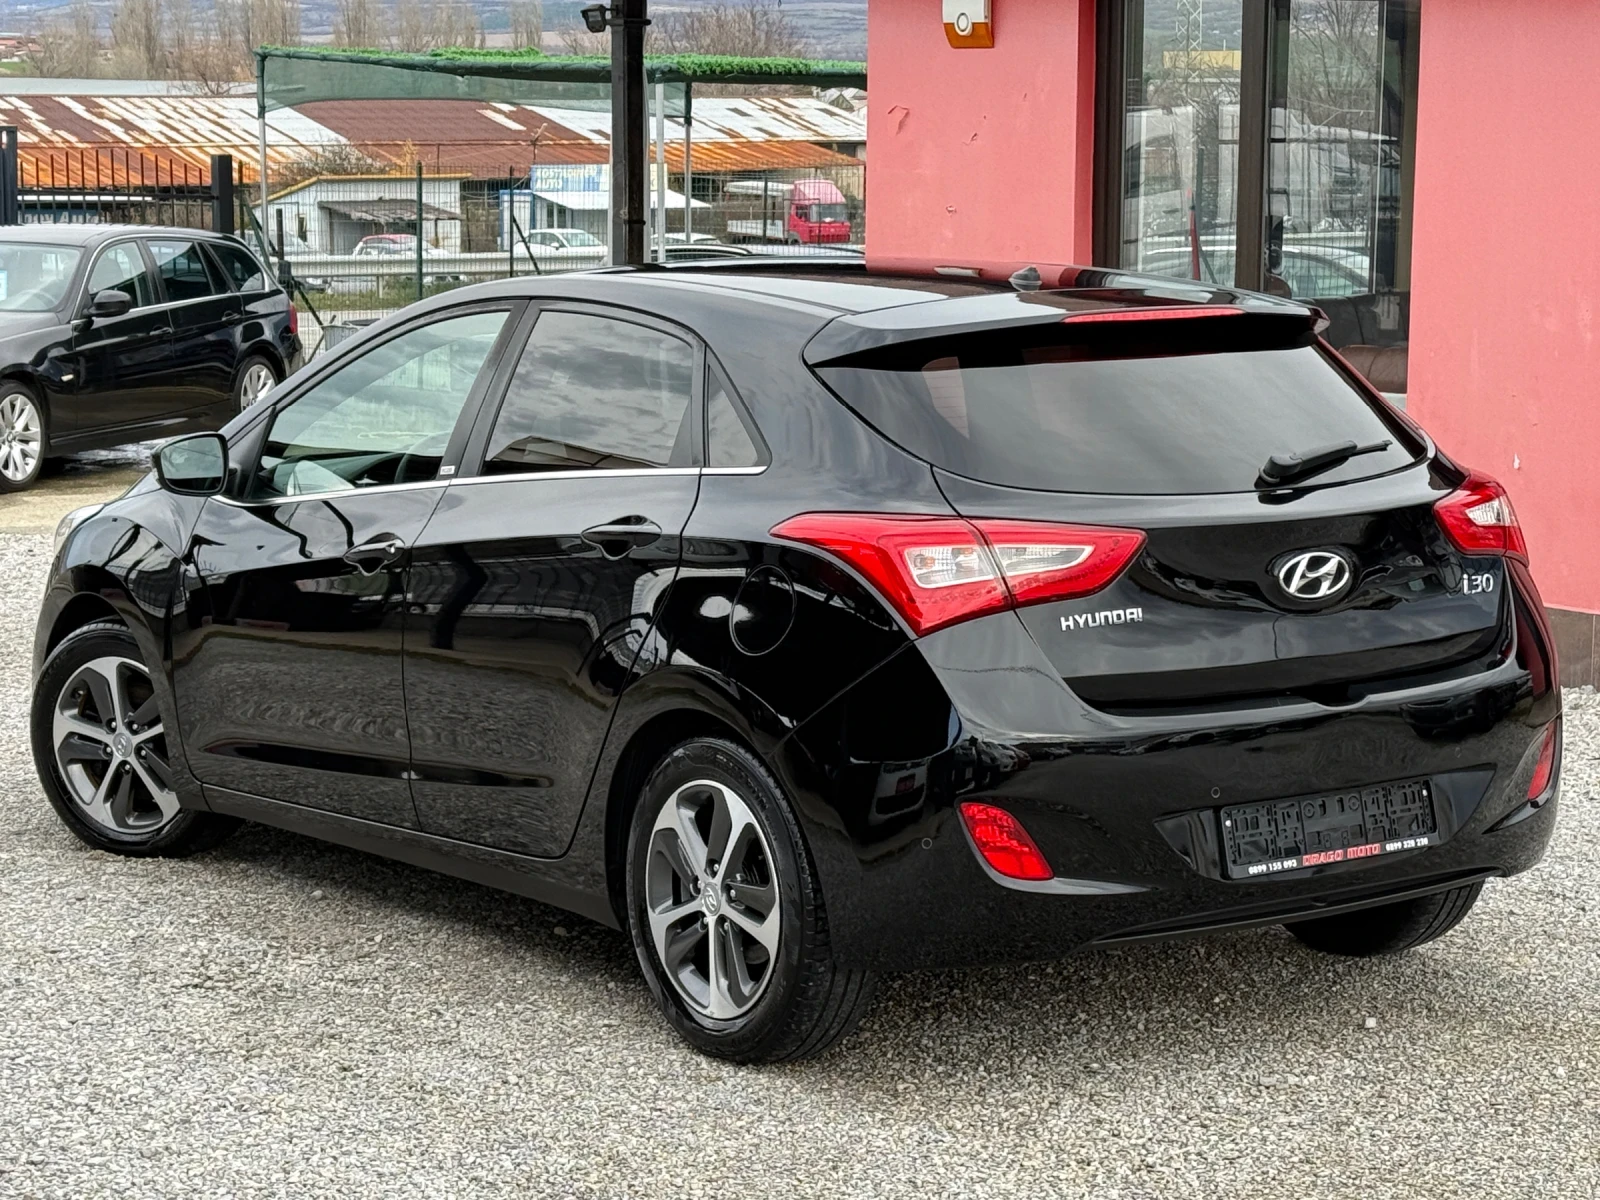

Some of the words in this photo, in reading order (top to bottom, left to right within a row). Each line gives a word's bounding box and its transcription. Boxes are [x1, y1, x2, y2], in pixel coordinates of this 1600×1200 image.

[535, 178, 563, 190] AUTO
[1463, 573, 1494, 595] i30
[1060, 607, 1143, 631] HYUNDAI
[1302, 850, 1344, 867] DRAGO
[1347, 843, 1382, 859] MOTO
